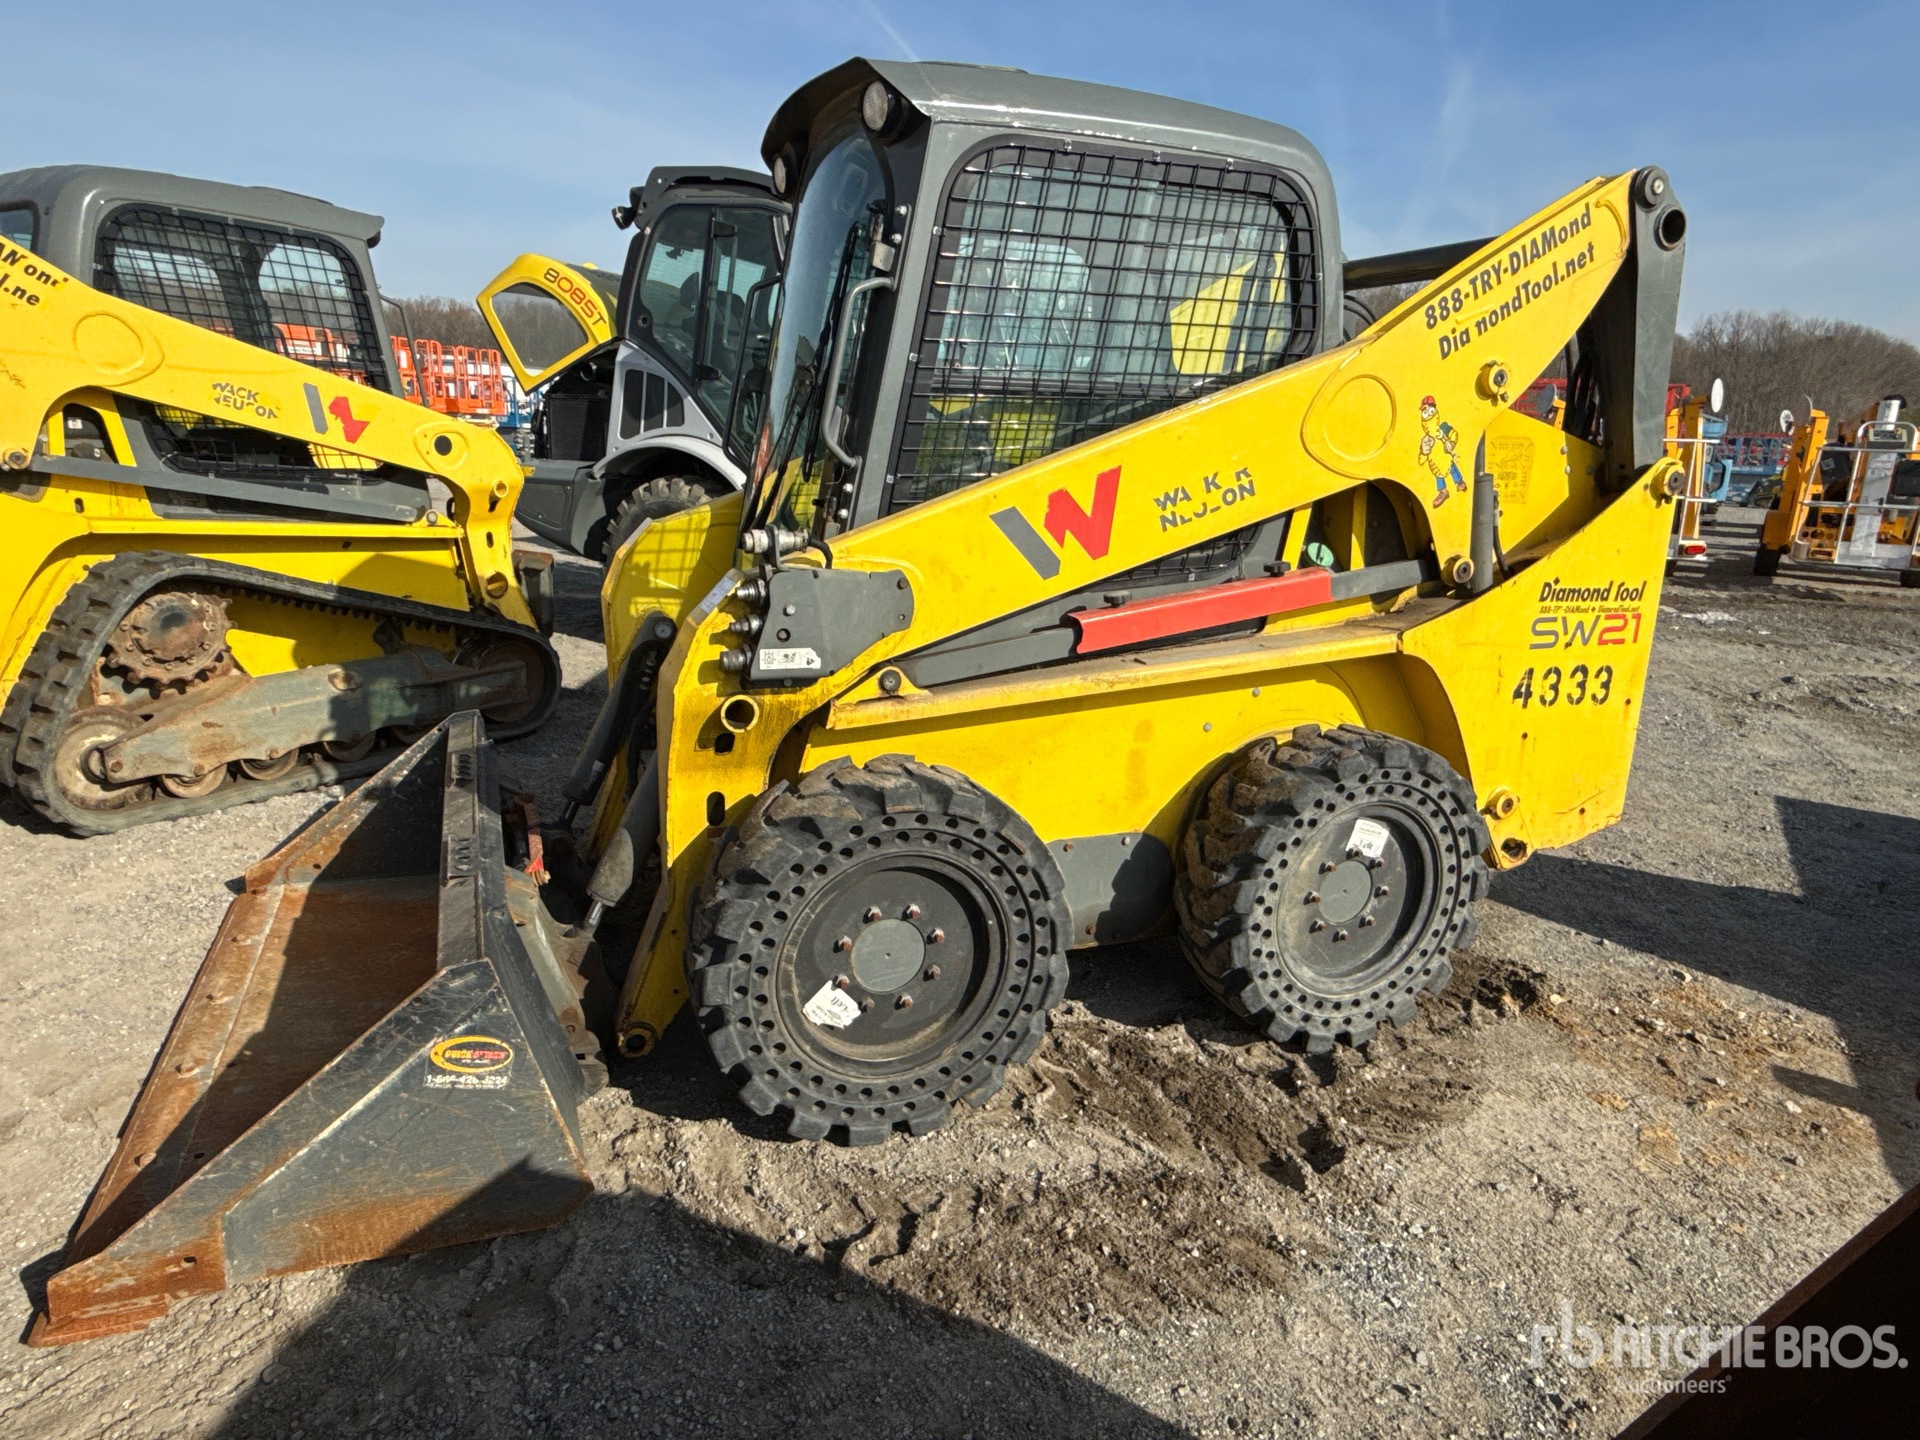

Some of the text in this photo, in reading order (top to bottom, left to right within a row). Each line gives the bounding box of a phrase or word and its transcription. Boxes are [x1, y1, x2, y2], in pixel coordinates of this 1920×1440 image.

[544, 267, 607, 326] 8085T
[1538, 576, 1614, 602] Diamond
[1528, 613, 1642, 650] SW21
[1511, 664, 1614, 709] 4333
